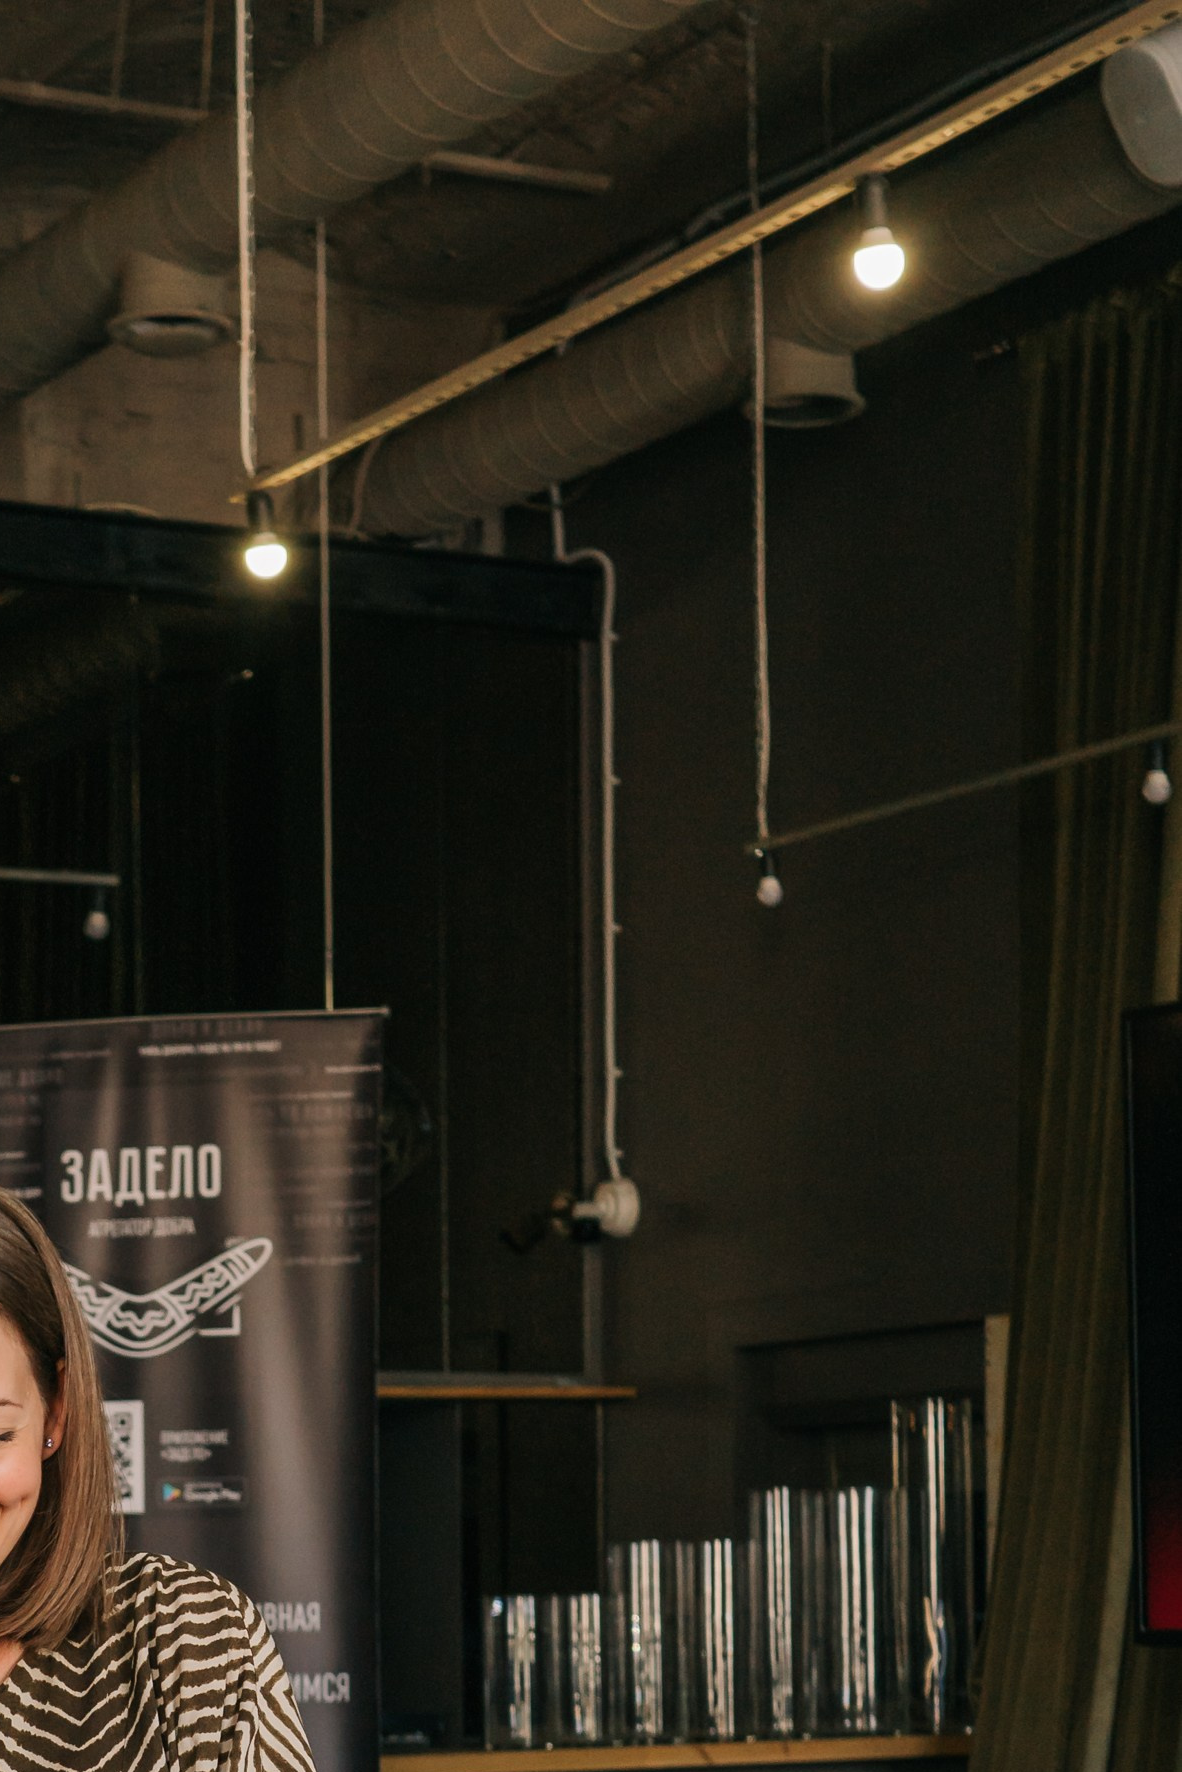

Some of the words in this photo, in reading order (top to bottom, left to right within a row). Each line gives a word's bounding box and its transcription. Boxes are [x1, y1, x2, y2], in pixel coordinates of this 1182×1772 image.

[60, 1143, 222, 1208] ЗАДЕЛО
[256, 1602, 320, 1632] ВНАЯ
[289, 1672, 350, 1703] ИМСЯ
